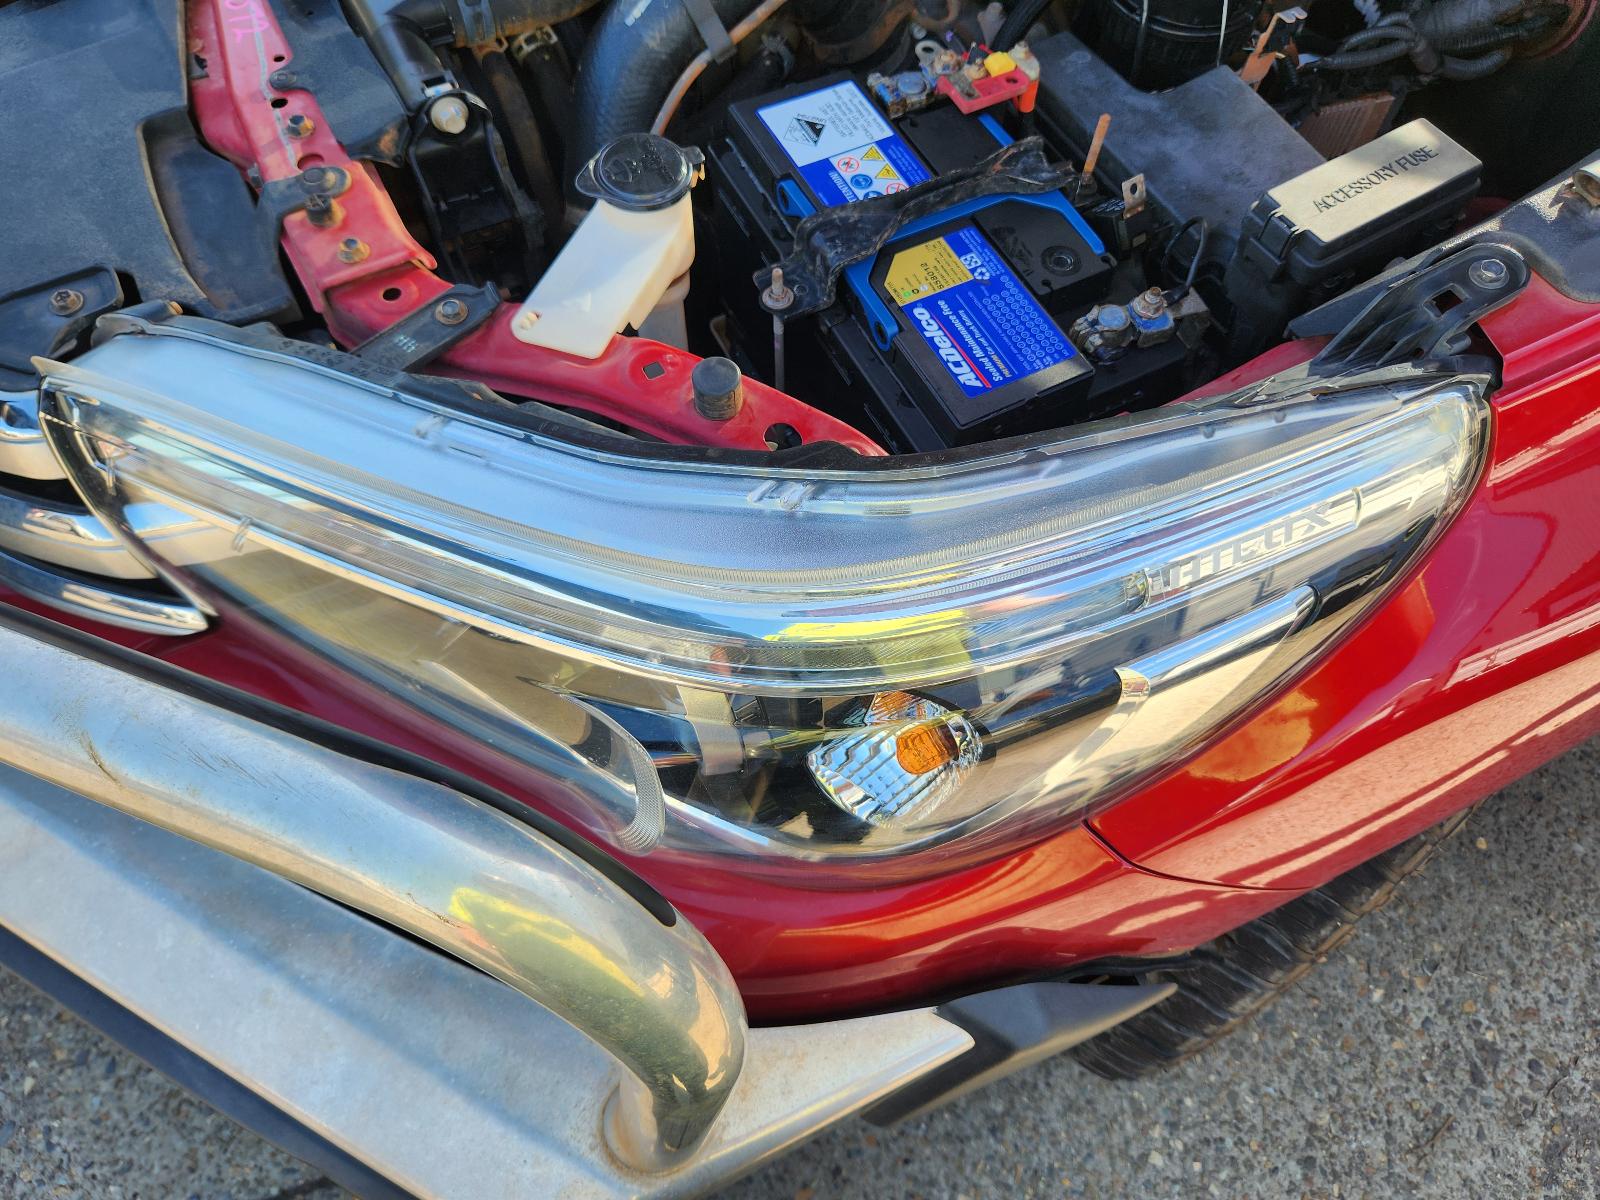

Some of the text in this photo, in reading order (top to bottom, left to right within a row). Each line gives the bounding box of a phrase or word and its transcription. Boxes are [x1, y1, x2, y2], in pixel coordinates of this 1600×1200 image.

[828, 170, 858, 203] TTENTION!
[1312, 146, 1439, 212] ACCESSORY FUSE
[937, 300, 953, 316] Free
[913, 307, 984, 388] ACDelco
[948, 315, 986, 357] Maintenance
[979, 356, 1003, 382] Sealed
